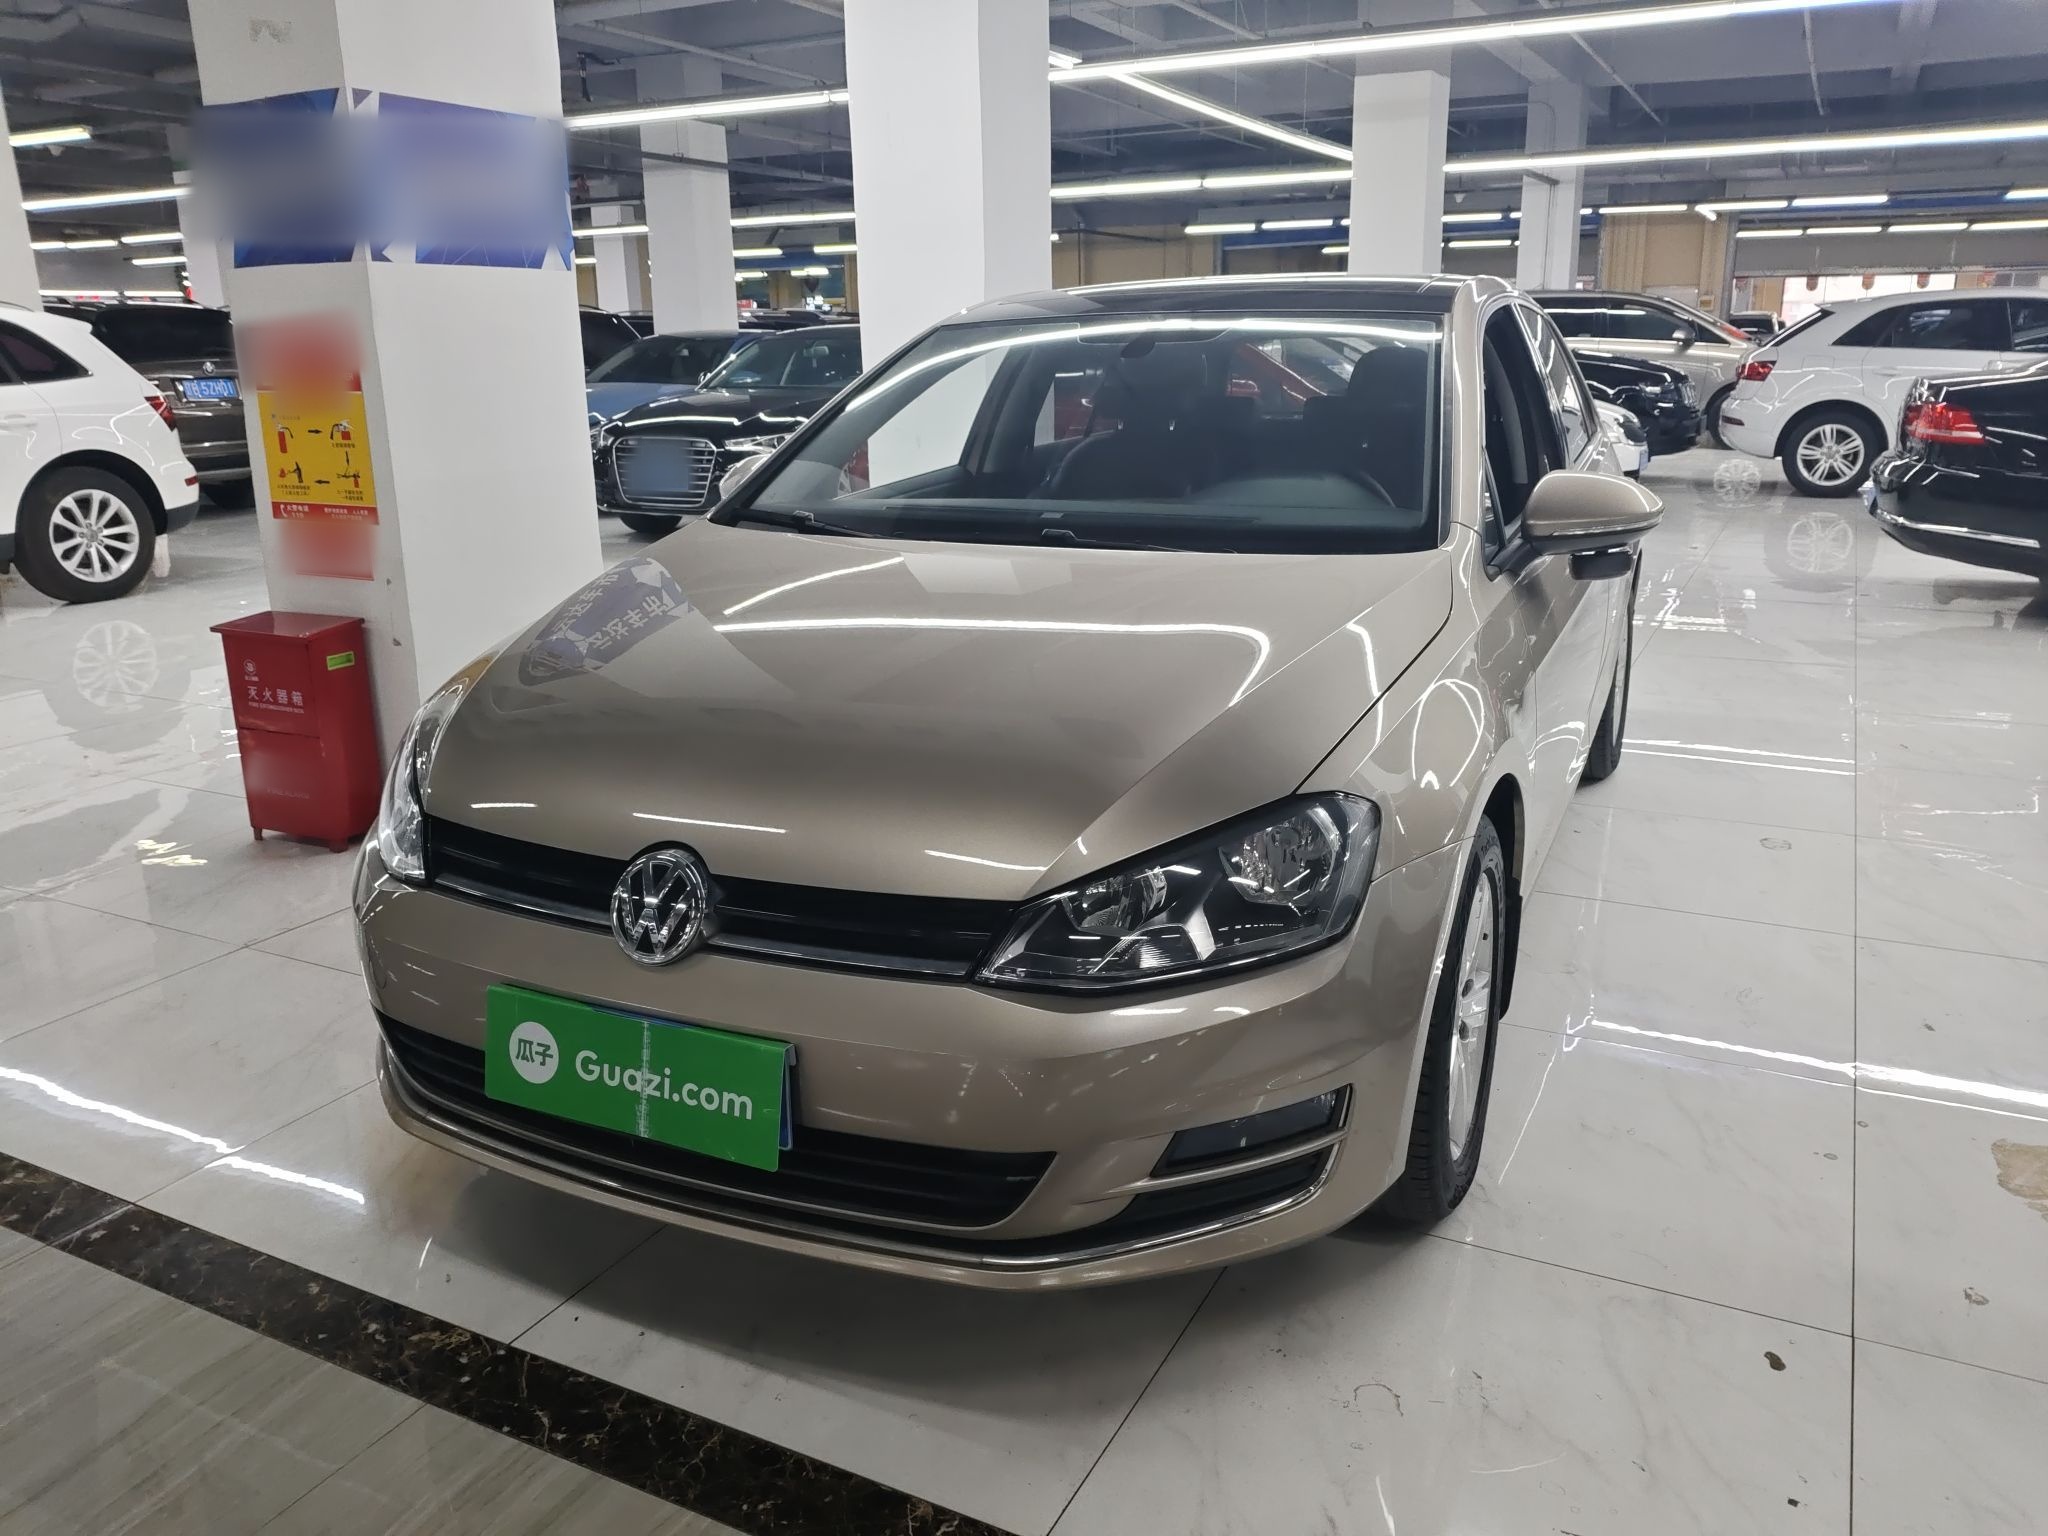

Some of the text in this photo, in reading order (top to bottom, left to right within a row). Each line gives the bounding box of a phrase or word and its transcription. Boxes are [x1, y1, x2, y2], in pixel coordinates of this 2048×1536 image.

[247, 685, 304, 707] 灭火器箱
[515, 1038, 554, 1067] 瓜子
[575, 1050, 753, 1120] Guazi.com
